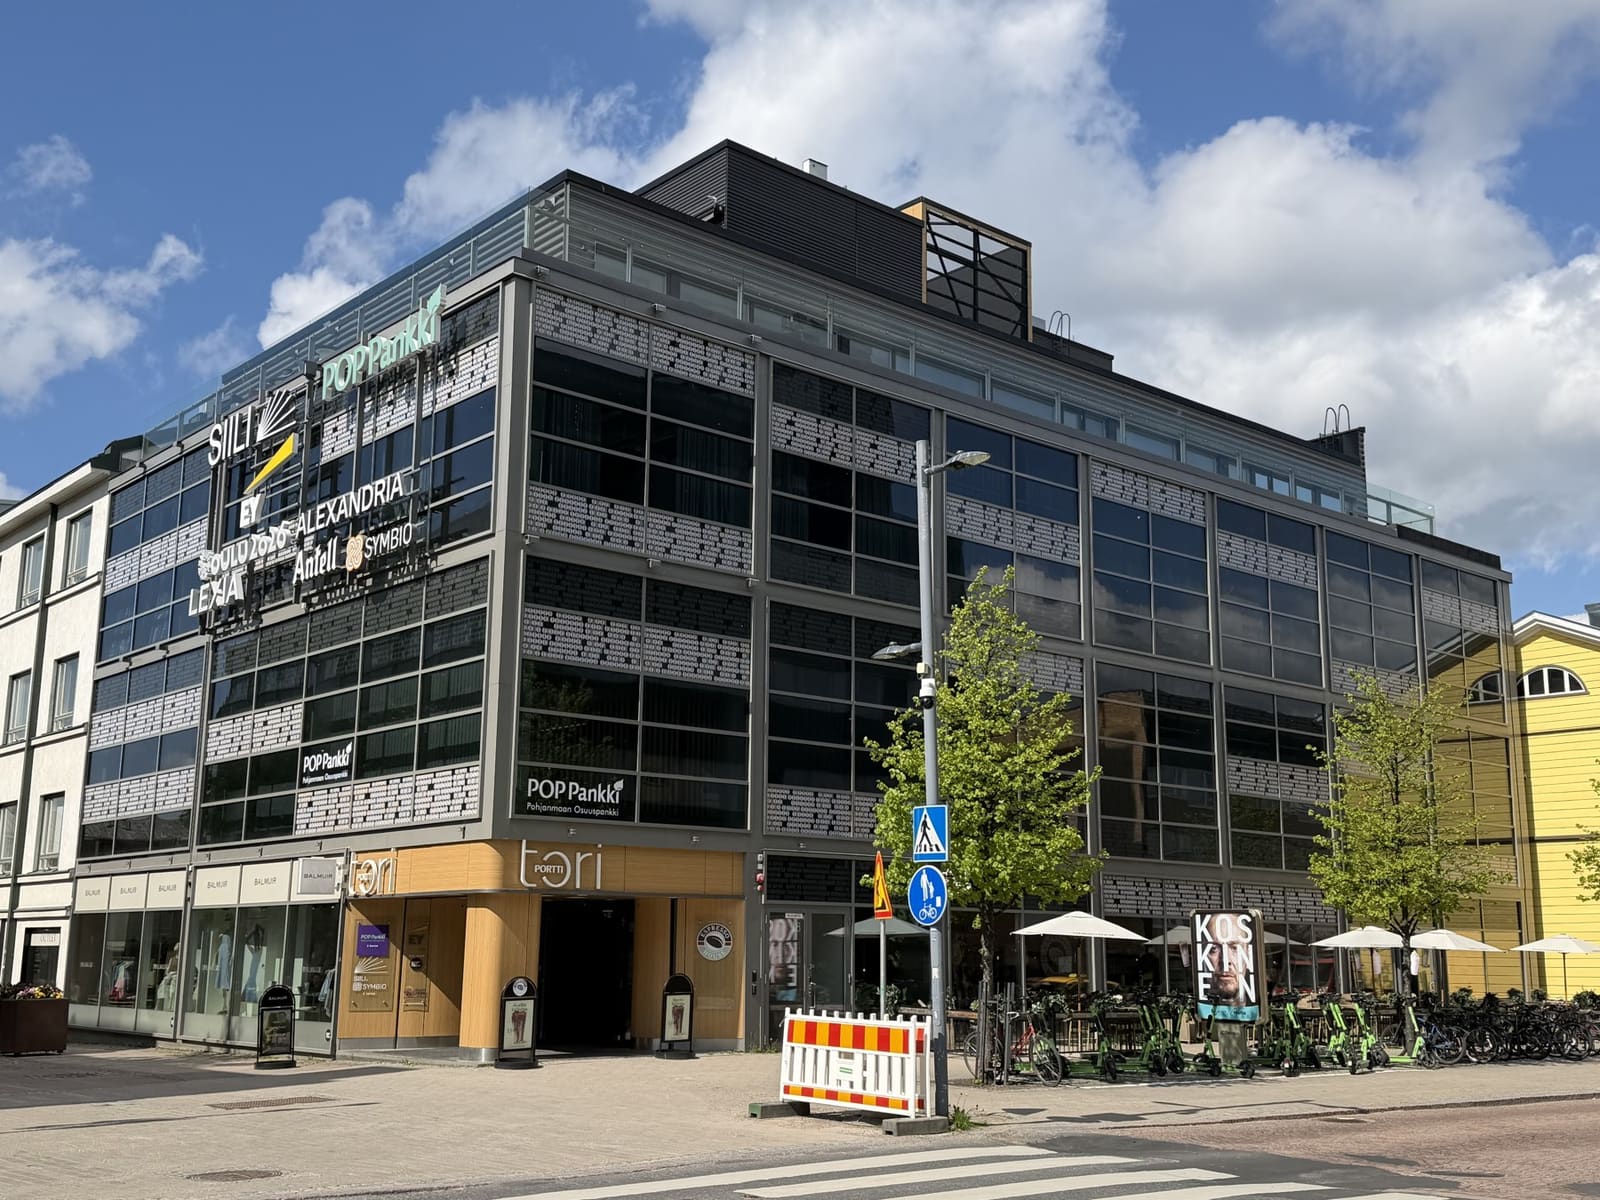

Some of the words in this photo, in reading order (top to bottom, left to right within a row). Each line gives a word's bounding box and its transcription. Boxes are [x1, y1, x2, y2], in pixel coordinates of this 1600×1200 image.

[322, 346, 366, 400] POP
[368, 285, 441, 375] Pankki
[208, 405, 252, 466] SIILI
[240, 494, 263, 527] EY
[296, 472, 403, 539] ALEXANDRIA
[364, 523, 412, 559] SYMBIO
[293, 536, 338, 584] Antell
[303, 753, 322, 773] POP
[322, 743, 352, 770] Pankki
[527, 778, 566, 799] POP
[568, 780, 622, 804] Pankki
[526, 802, 572, 812] Pohjanmaan
[574, 805, 619, 816] Osuuspankki
[534, 864, 564, 874] PORTTI
[1195, 913, 1253, 943] KOS
[1197, 943, 1254, 973] KIN
